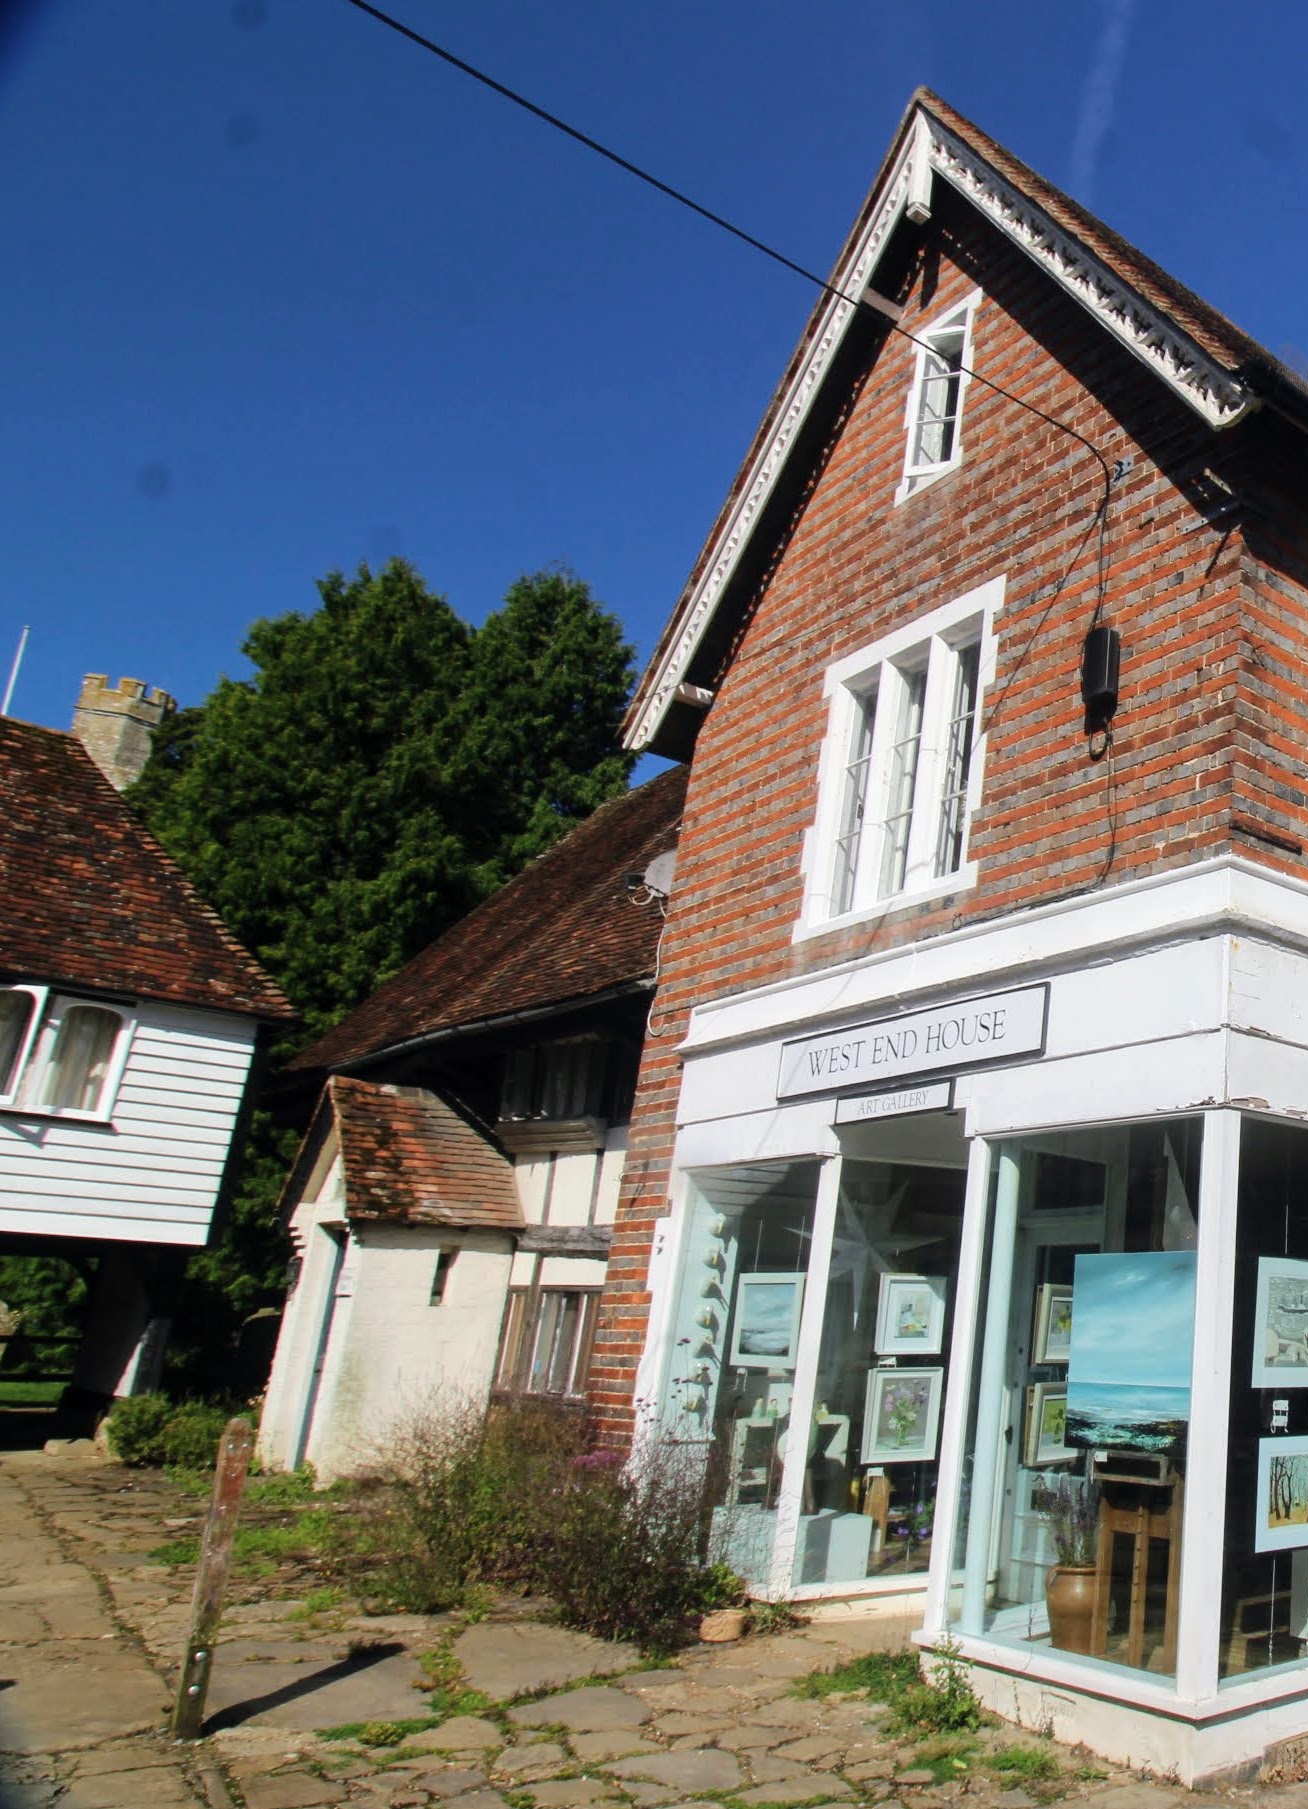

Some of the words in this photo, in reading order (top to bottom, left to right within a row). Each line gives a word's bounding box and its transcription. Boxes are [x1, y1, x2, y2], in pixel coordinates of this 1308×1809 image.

[808, 1041, 866, 1078] WEST
[871, 1029, 917, 1065] END
[925, 1009, 1006, 1054] HOUSE
[857, 1095, 880, 1116] ART
[882, 1089, 929, 1112] GALLERY
